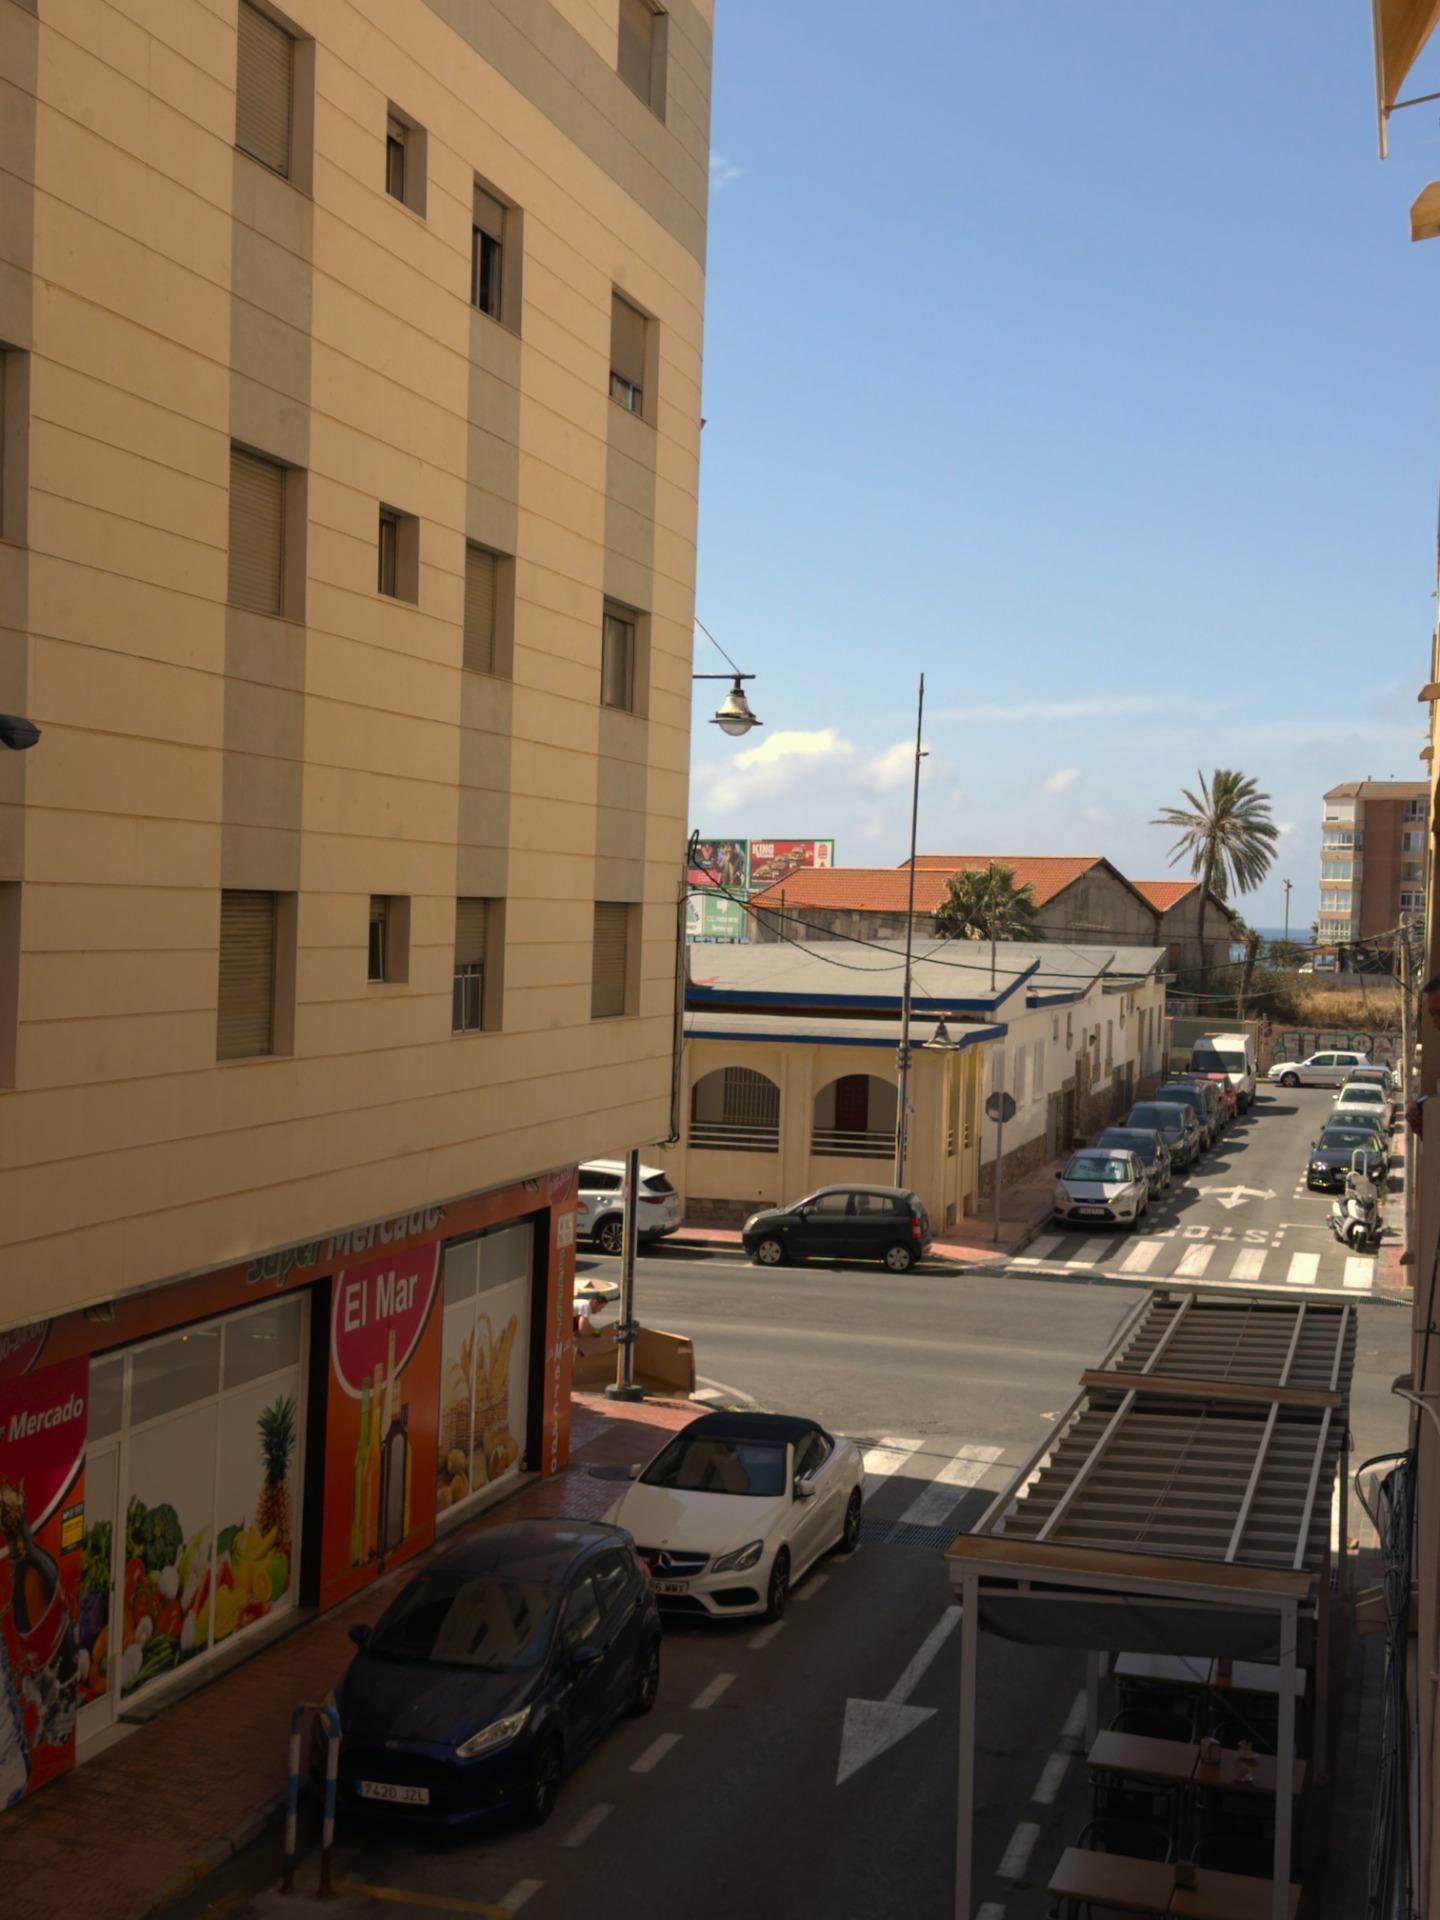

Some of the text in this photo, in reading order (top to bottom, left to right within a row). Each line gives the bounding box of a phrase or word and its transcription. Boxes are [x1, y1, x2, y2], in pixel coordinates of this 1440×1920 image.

[344, 1270, 419, 1332] El Mar
[8, 1393, 84, 1443] Mercado
[365, 1783, 426, 1802] 7420 JZL
